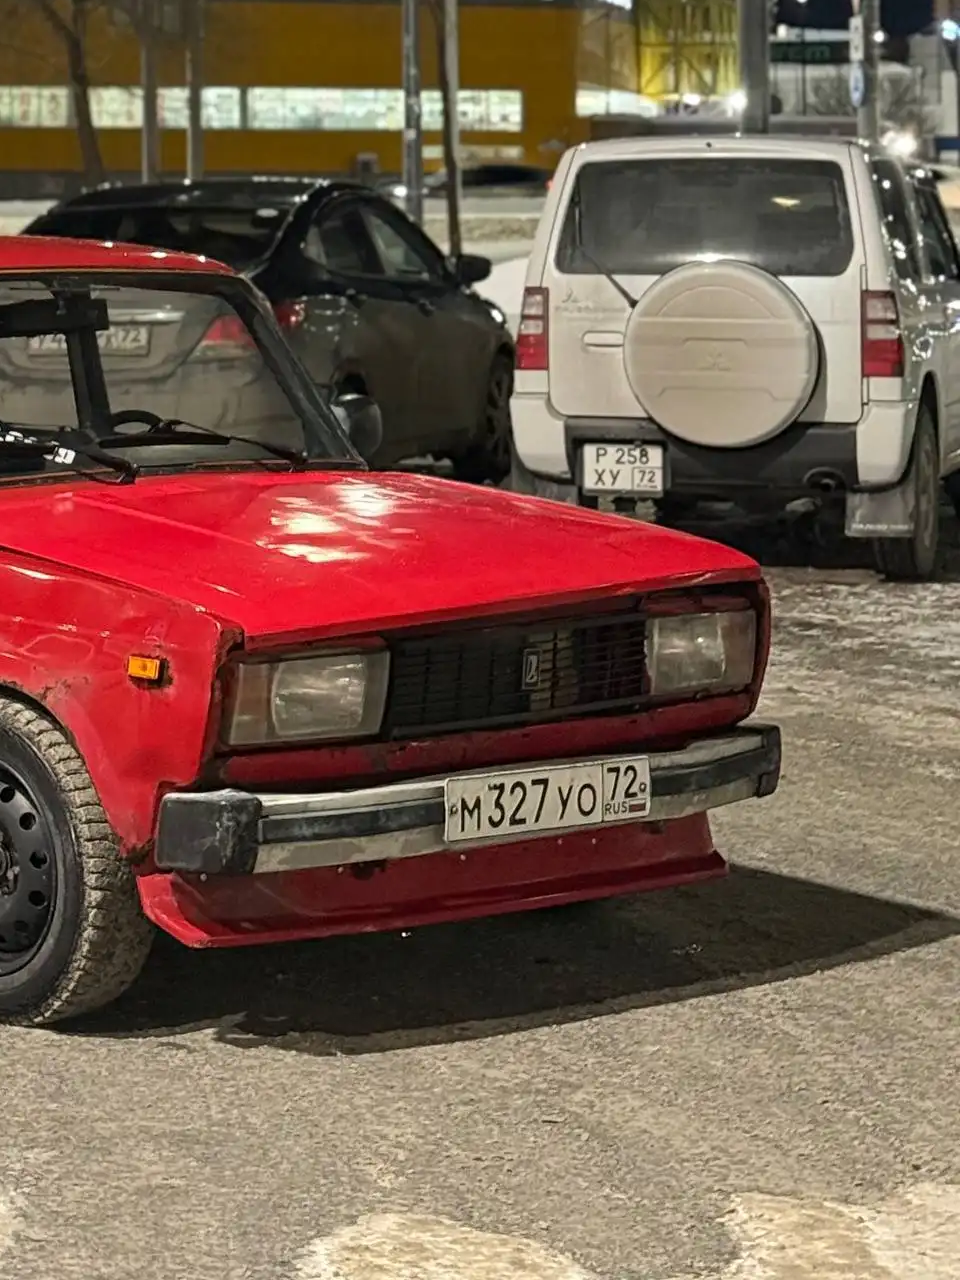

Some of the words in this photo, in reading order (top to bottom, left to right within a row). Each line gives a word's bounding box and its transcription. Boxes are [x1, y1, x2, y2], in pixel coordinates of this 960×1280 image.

[638, 469, 656, 483] 72
[606, 765, 638, 801] 72
[604, 801, 628, 815] RUS
